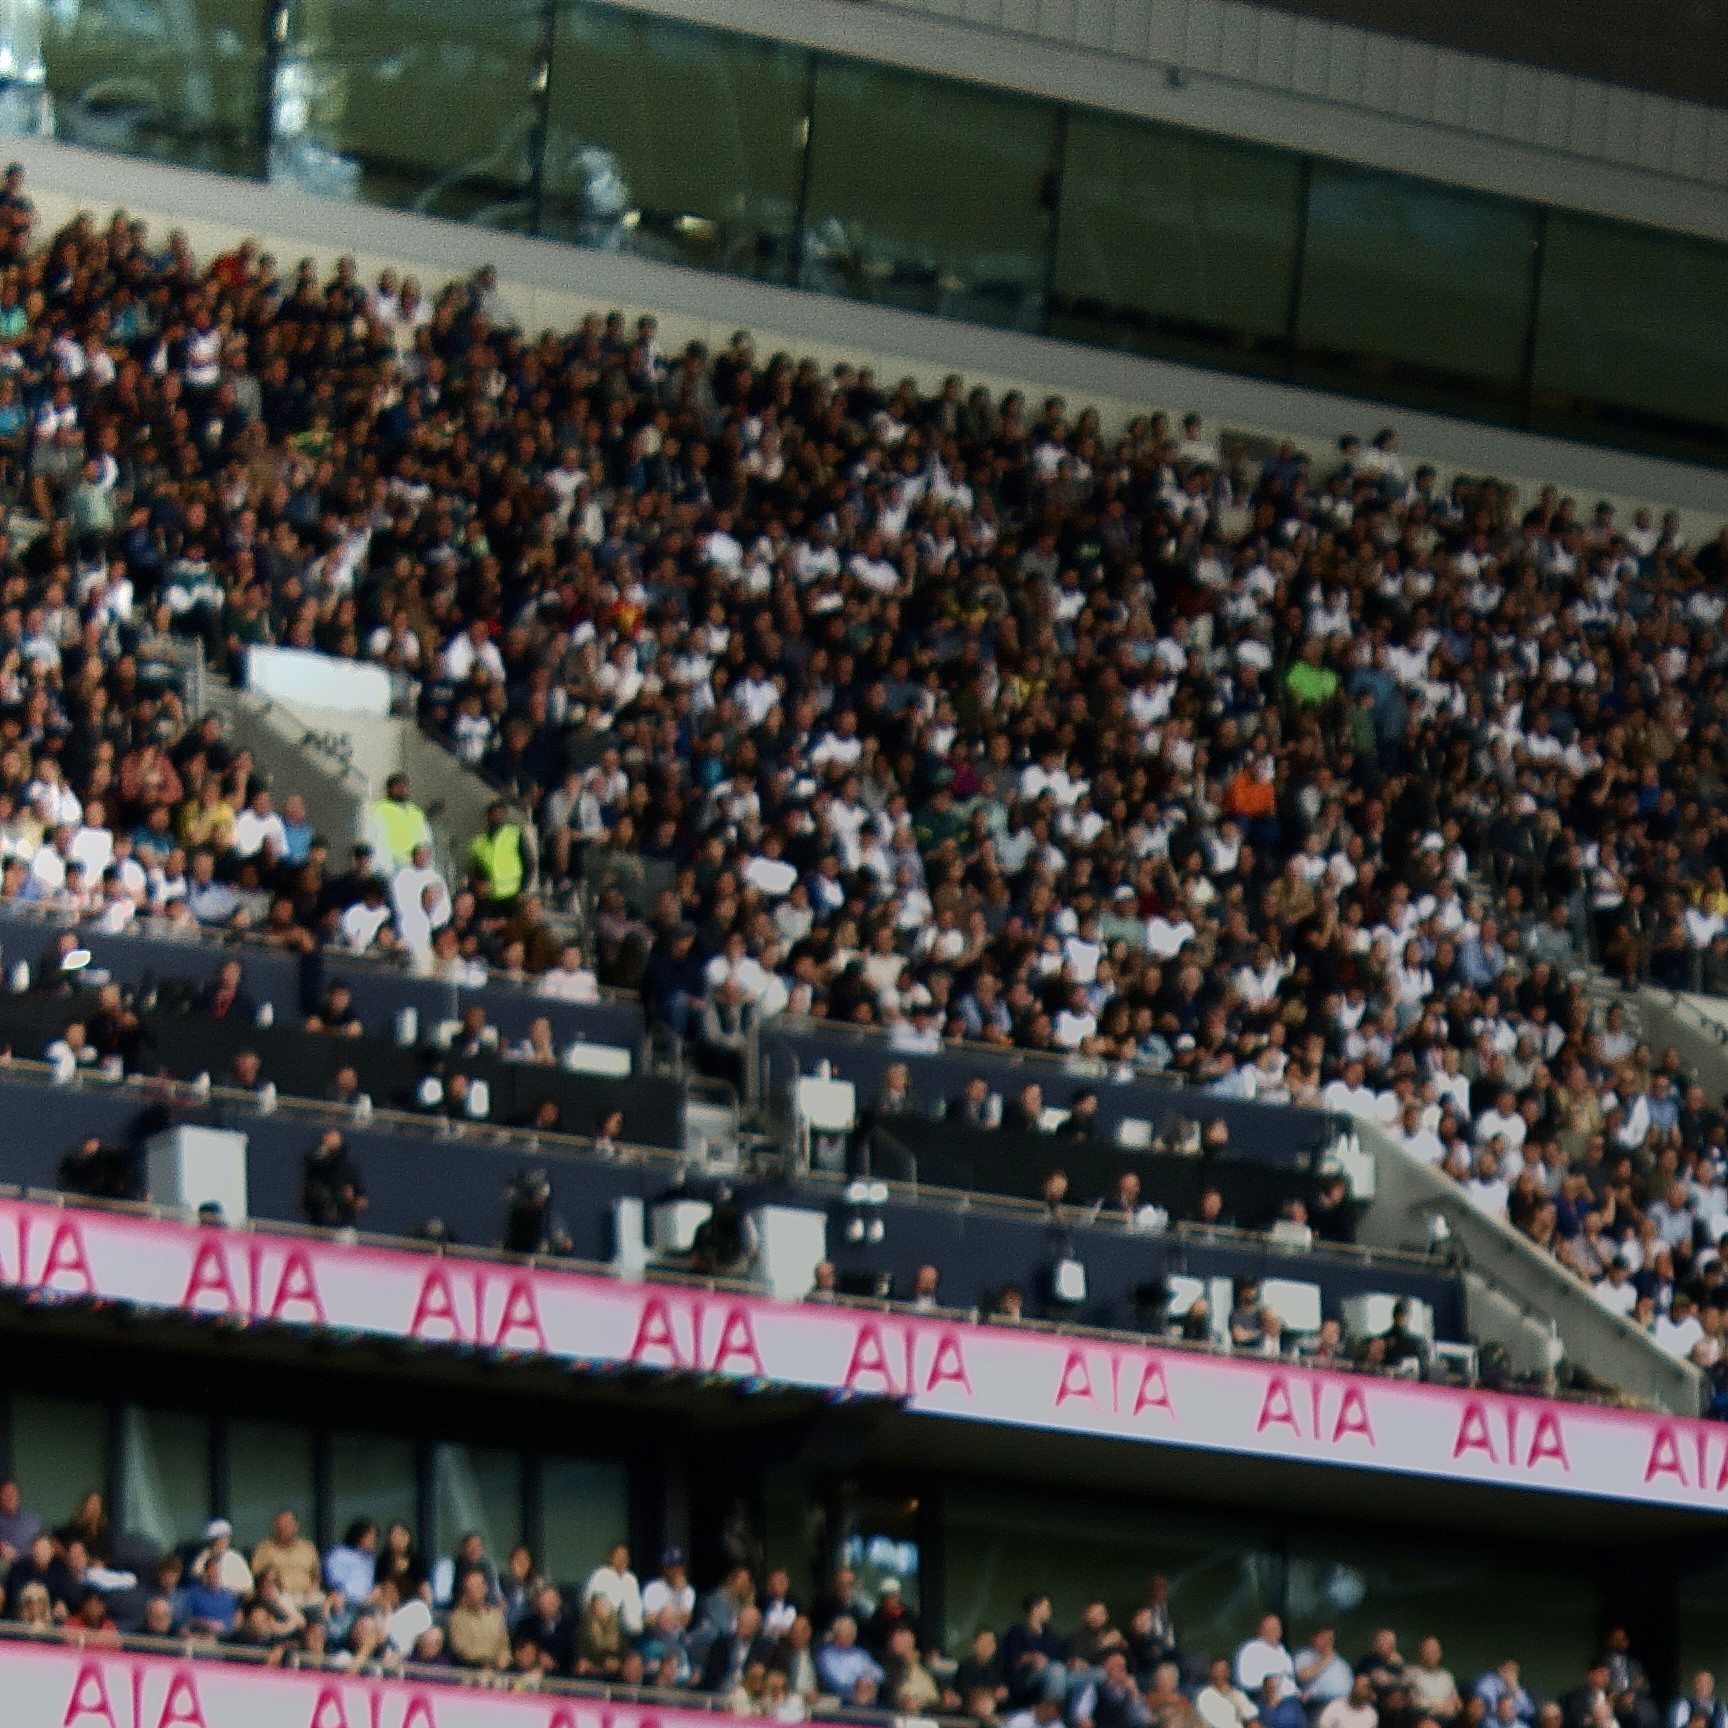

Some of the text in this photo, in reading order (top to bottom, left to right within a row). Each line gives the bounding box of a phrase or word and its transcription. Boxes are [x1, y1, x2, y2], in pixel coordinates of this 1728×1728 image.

[0, 1212, 96, 1296] IA
[183, 1236, 326, 1324] AIA
[410, 1264, 547, 1352] AIA
[630, 1292, 765, 1375] AIA
[844, 1323, 971, 1398] AIA
[1056, 1349, 1177, 1422] AIA
[1257, 1375, 1377, 1449] AIA
[1453, 1400, 1570, 1473] AIA
